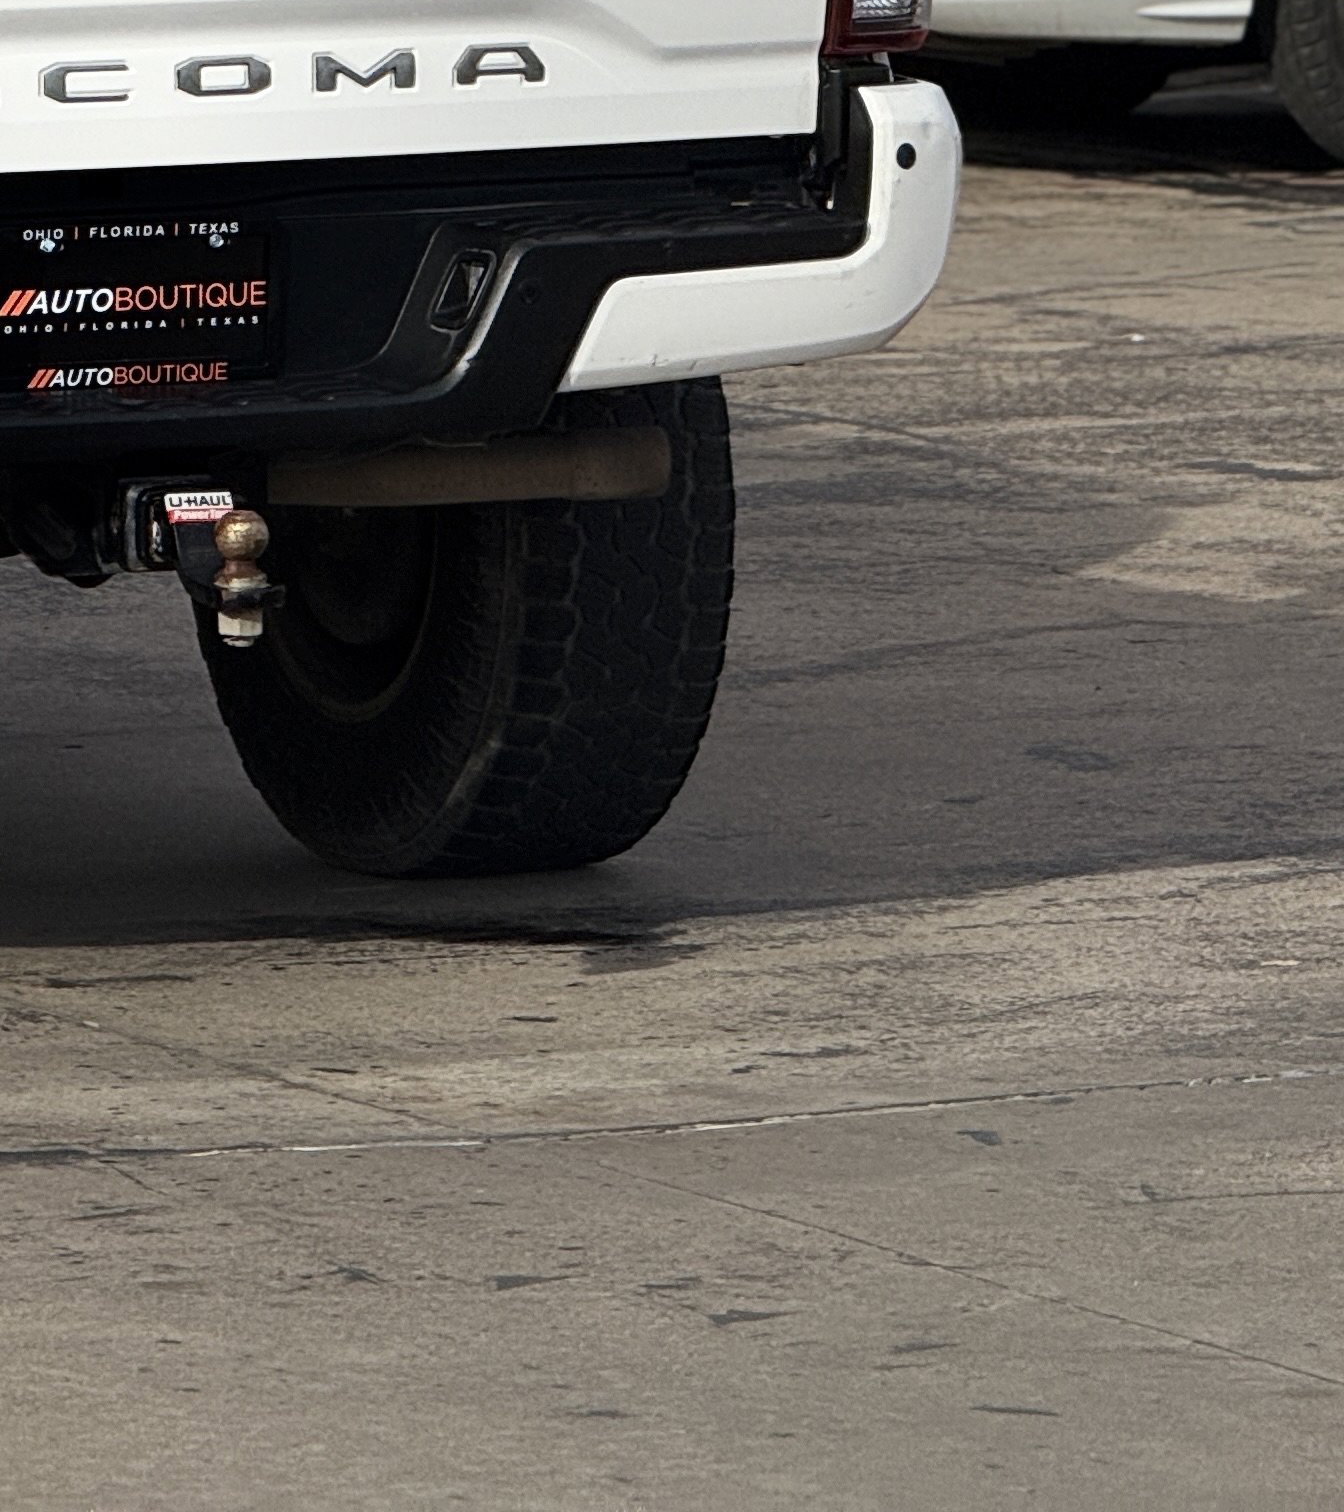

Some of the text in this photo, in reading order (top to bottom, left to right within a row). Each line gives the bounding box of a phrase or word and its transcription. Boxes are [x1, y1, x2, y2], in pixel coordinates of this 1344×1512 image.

[23, 221, 240, 241] OHIO FLORIDA TEXAS
[4, 315, 259, 335] OHIO FLORIDA TEXAS
